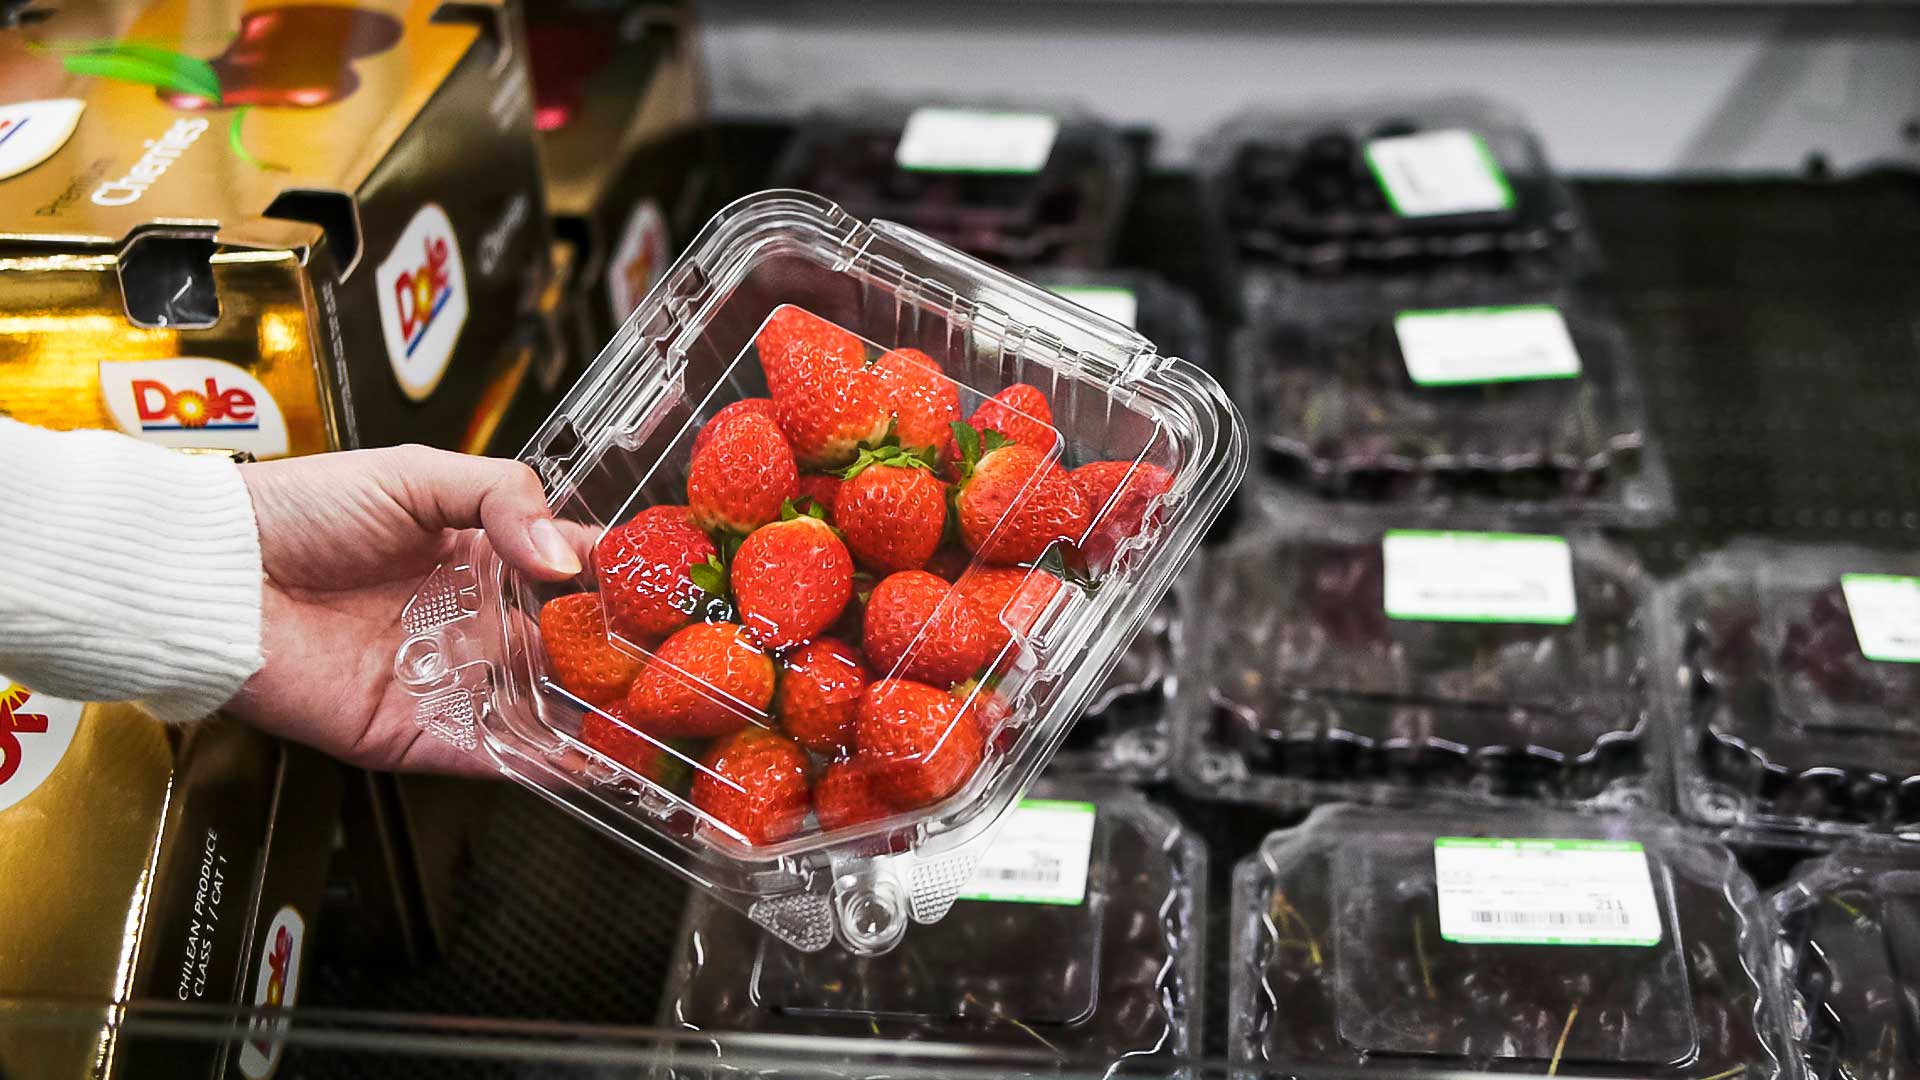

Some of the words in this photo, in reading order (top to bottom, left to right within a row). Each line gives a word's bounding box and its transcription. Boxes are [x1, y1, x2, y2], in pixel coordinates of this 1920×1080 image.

[91, 118, 209, 206] Cherries
[396, 238, 449, 342] Dole
[132, 377, 256, 428] Dole
[178, 918, 201, 1001] CHILEAN
[194, 827, 218, 917] PRODUCE
[194, 938, 213, 997] CLASS
[211, 867, 225, 905] CAT
